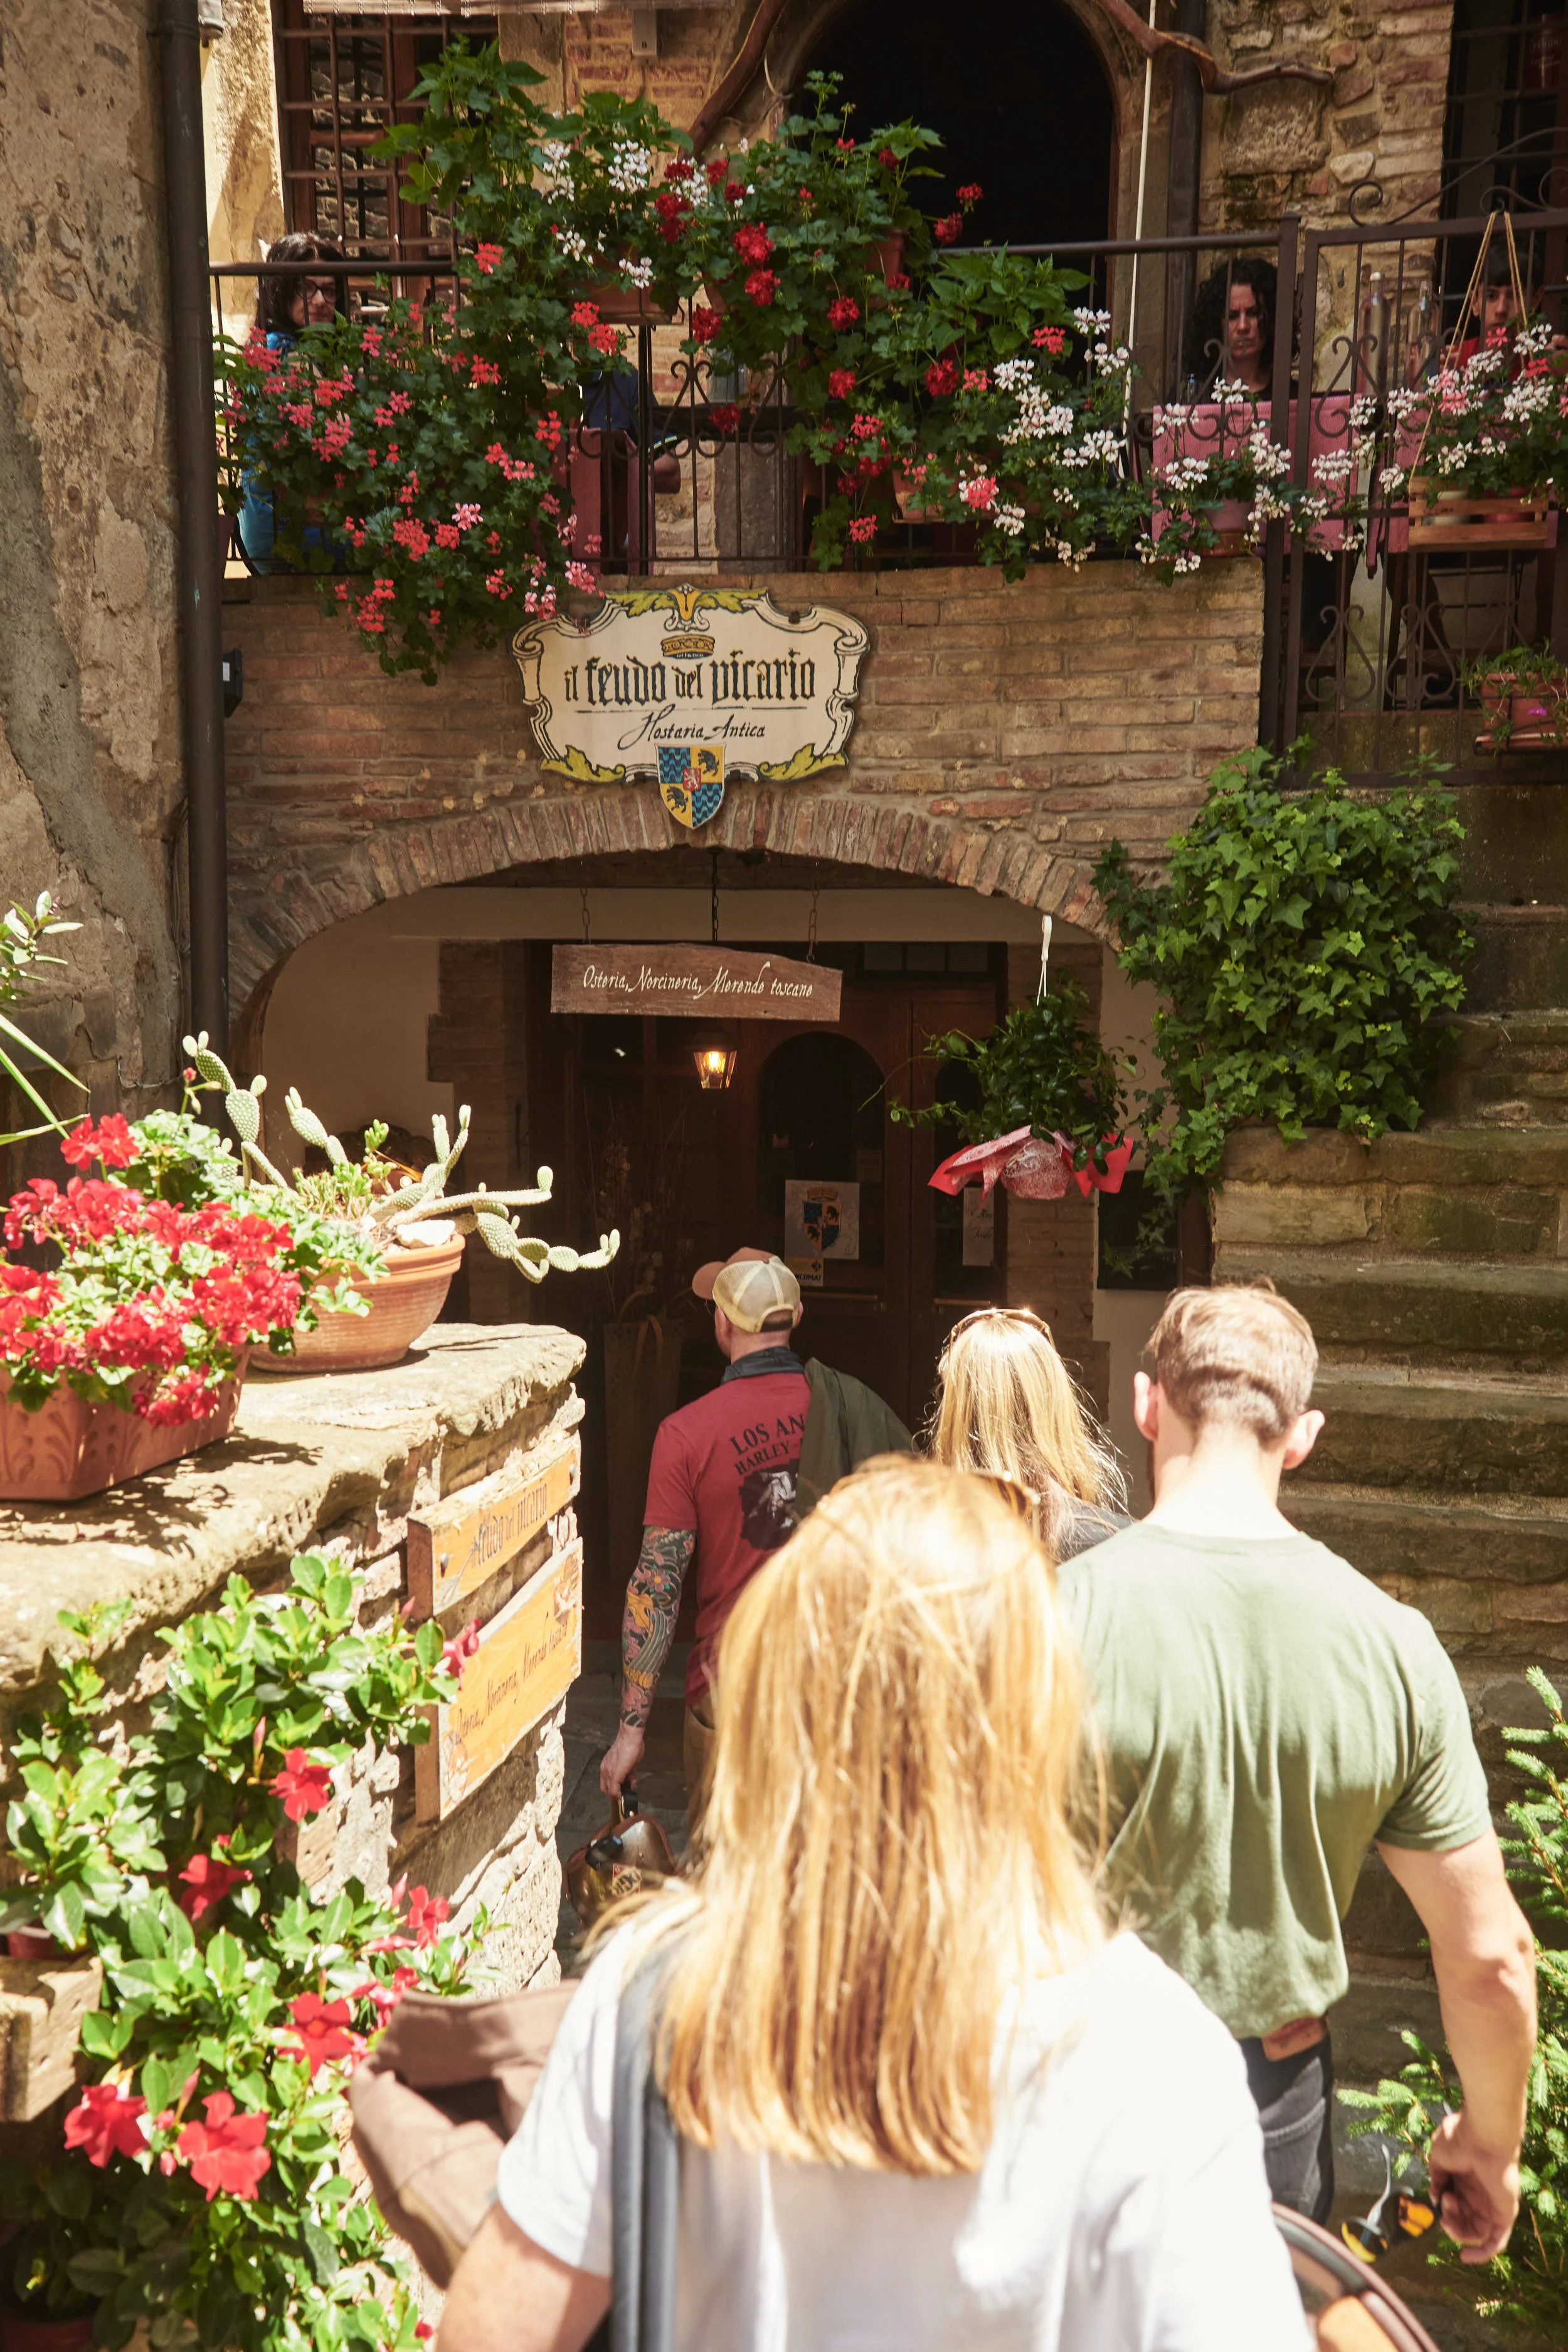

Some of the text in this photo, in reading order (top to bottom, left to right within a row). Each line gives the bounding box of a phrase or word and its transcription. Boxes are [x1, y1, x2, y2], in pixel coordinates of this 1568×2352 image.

[564, 665, 579, 702] il
[585, 654, 667, 707] feudo
[672, 664, 702, 699] del
[617, 703, 766, 750] Hostaria Antica
[692, 961, 771, 1000] Merende
[770, 977, 813, 998] toscane
[729, 1414, 805, 1456] LOS AN
[733, 1440, 790, 1476] HARLEY
